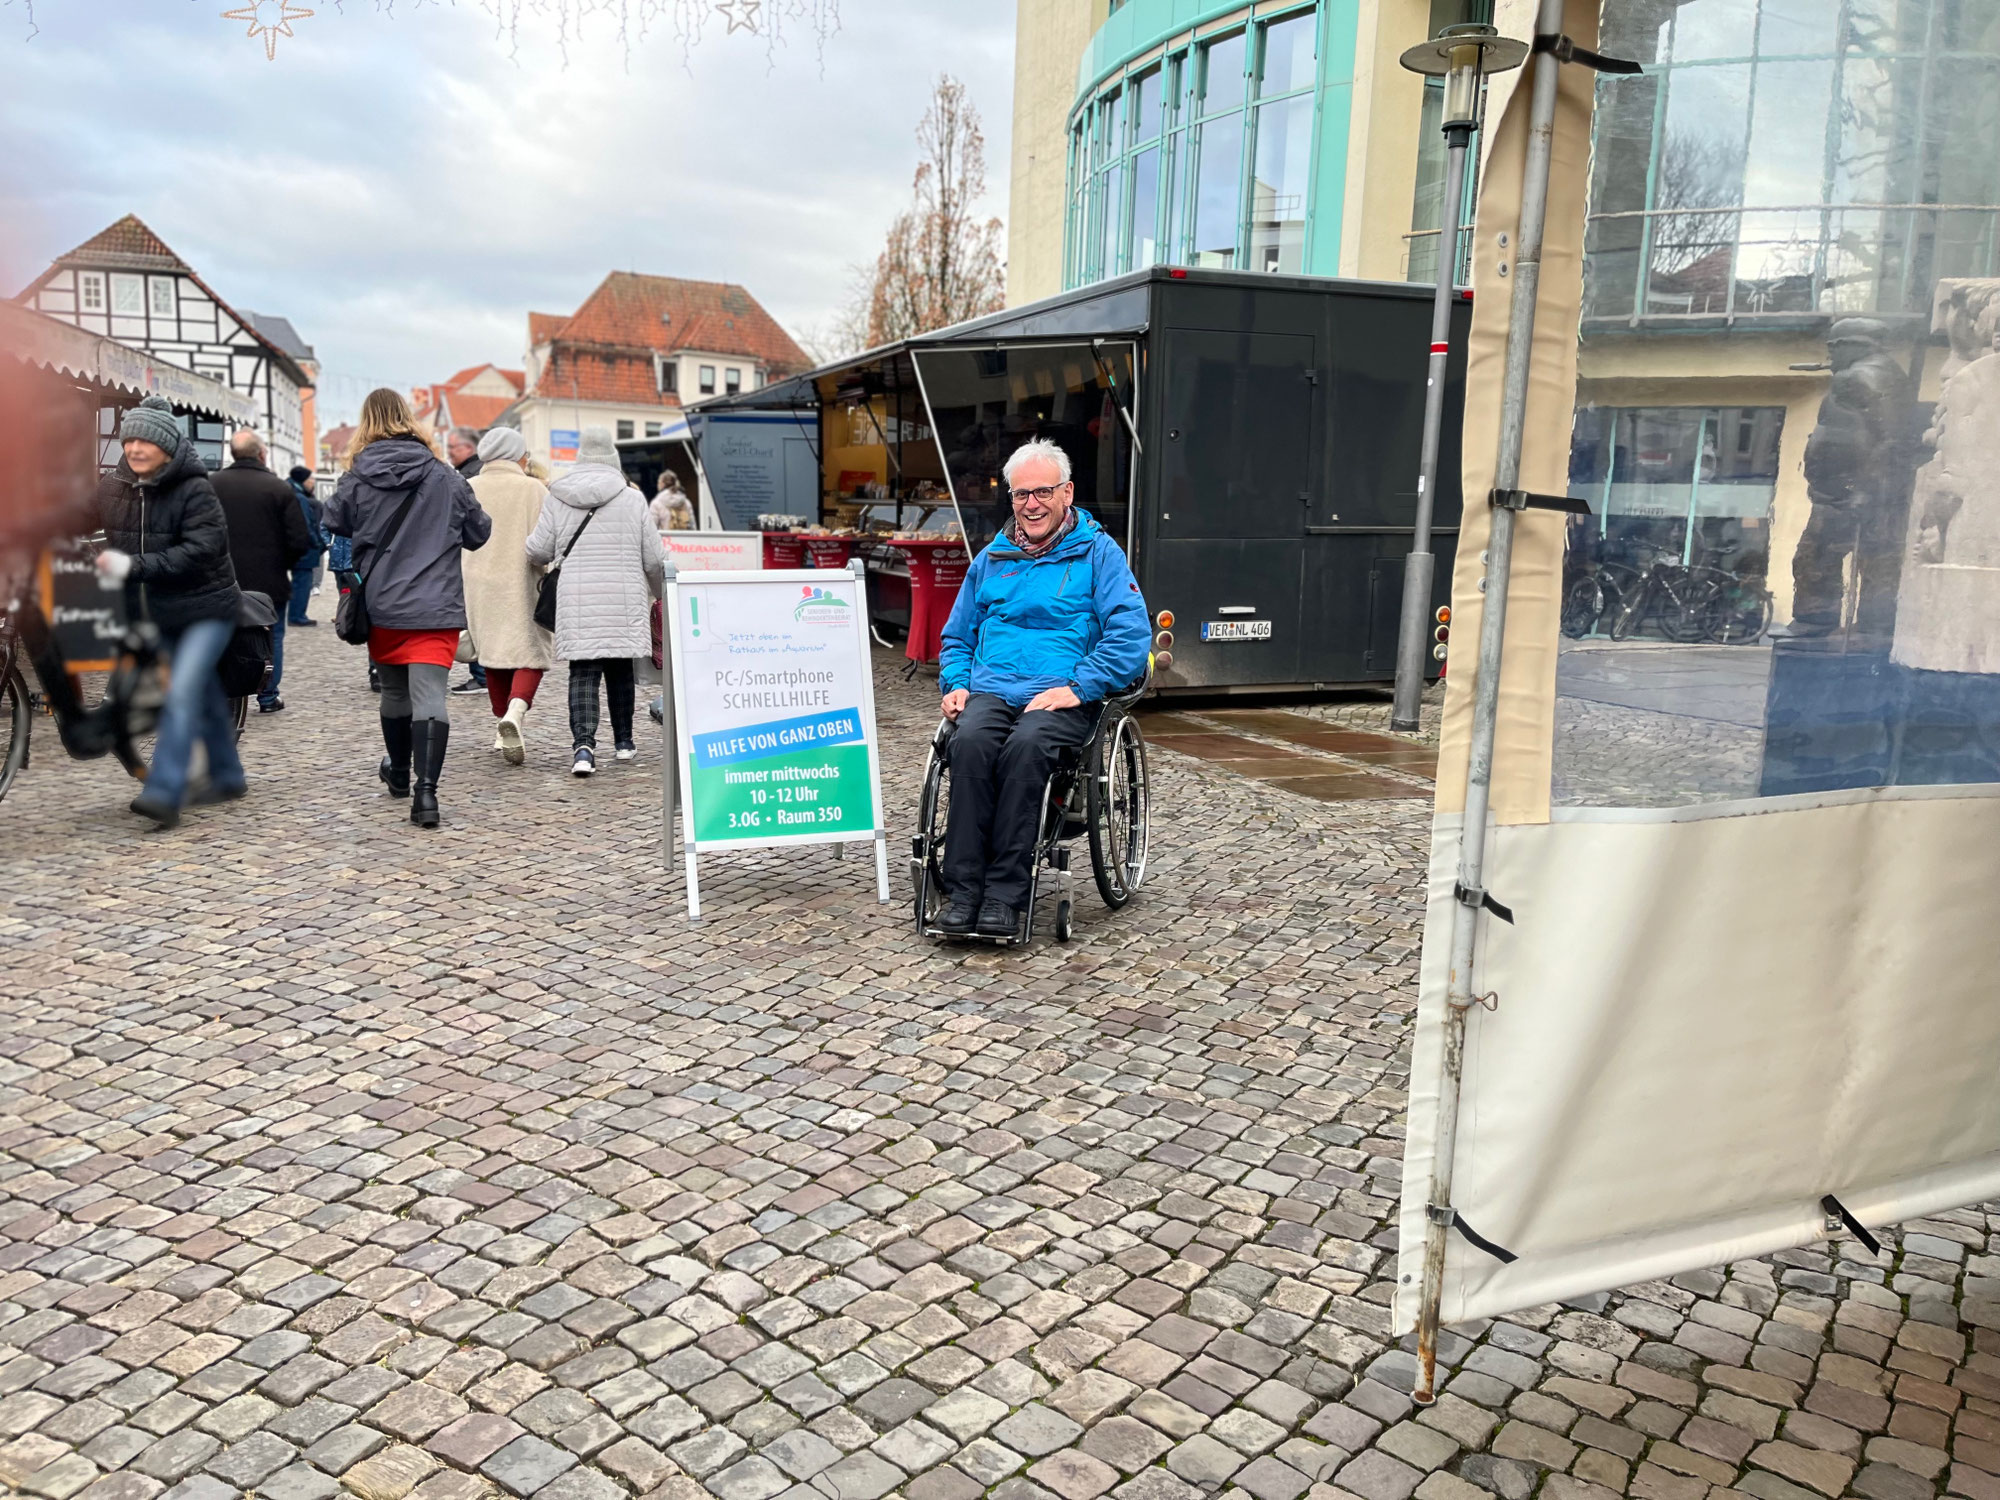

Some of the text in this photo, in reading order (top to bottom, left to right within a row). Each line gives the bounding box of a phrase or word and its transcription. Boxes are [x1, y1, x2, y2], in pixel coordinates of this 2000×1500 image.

[1210, 624, 1228, 636] VER
[1251, 623, 1270, 635] 406
[715, 668, 834, 687] PC-/Smartphone
[723, 690, 830, 710] SCHNELLHILFE
[707, 719, 853, 759] HILFE VON GANZ OBEN
[725, 764, 840, 784] immer mittwochs
[750, 789, 766, 805] 10
[776, 788, 792, 803] 12
[795, 786, 819, 801] Uhr
[778, 809, 815, 824] Raum
[818, 806, 842, 821] 350
